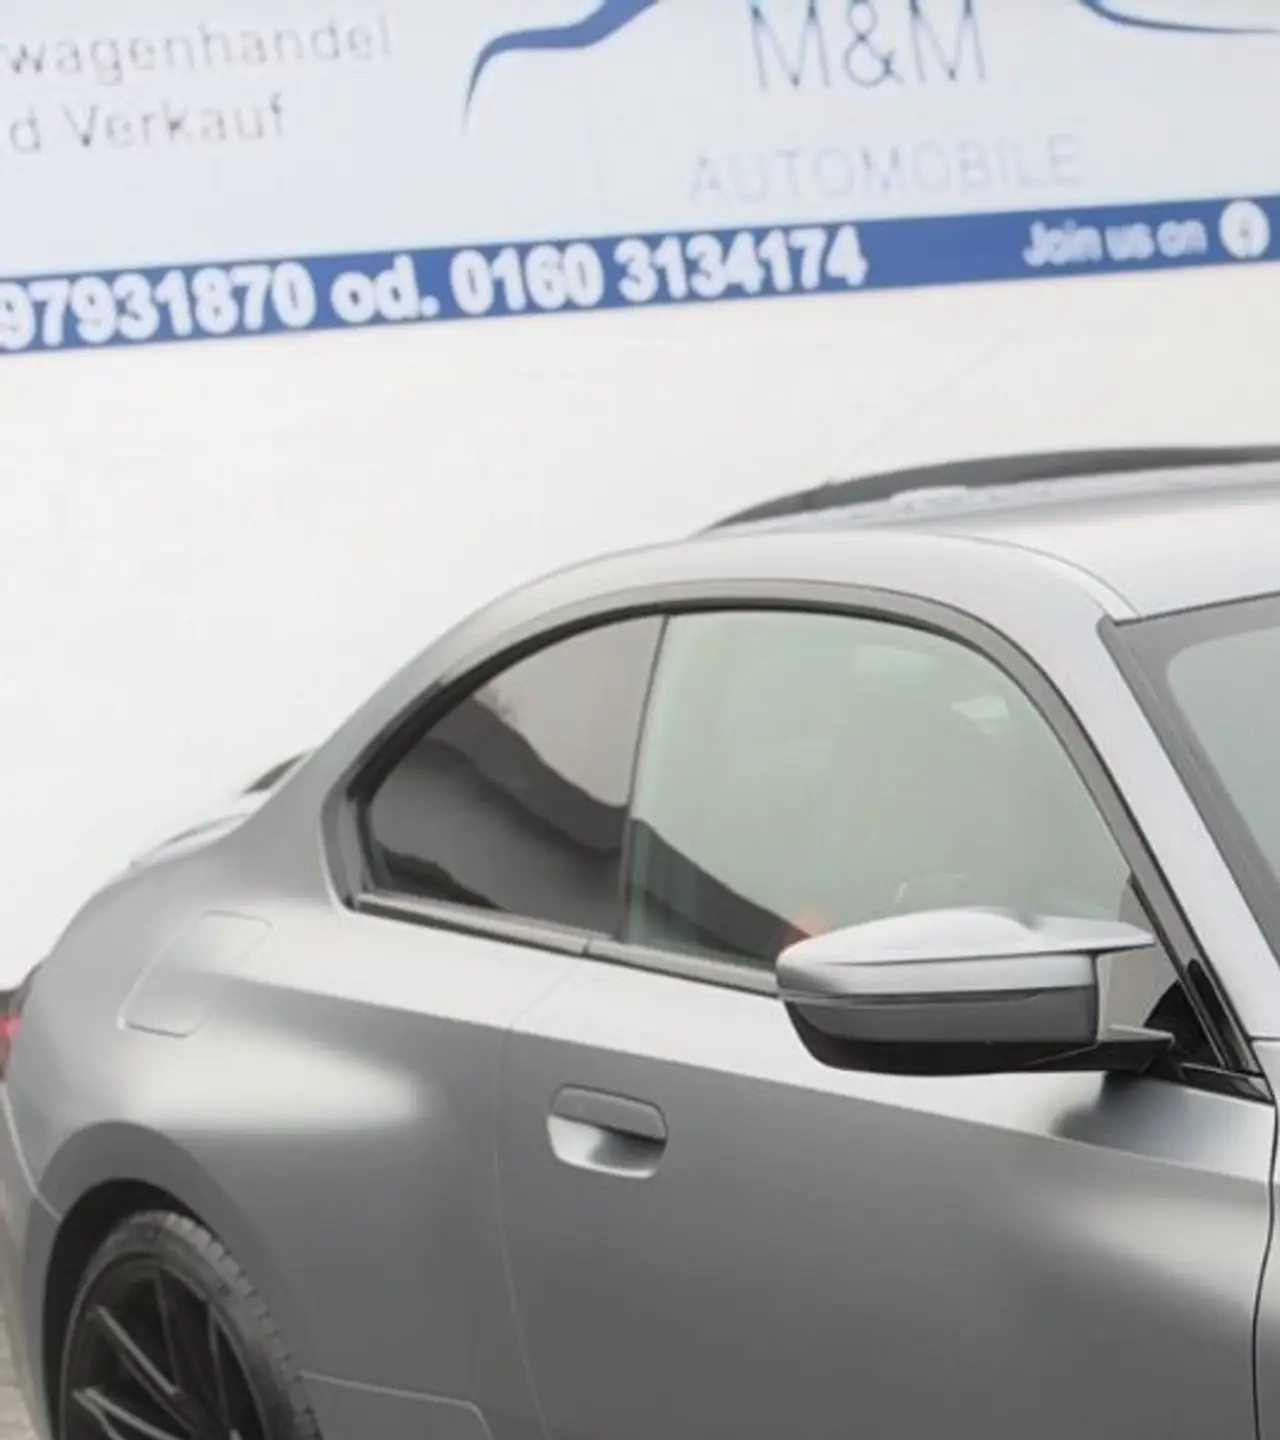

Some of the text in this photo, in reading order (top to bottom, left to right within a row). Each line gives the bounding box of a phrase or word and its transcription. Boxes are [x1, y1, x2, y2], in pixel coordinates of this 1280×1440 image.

[0, 13, 391, 86] wagenhandel
[747, 0, 987, 91] M&M
[61, 89, 286, 150] Verkauf
[690, 133, 1085, 205] AUTOMOBILE
[1022, 217, 1209, 267] Join us on
[0, 226, 868, 350] 97931870 od. 0160 3134174
